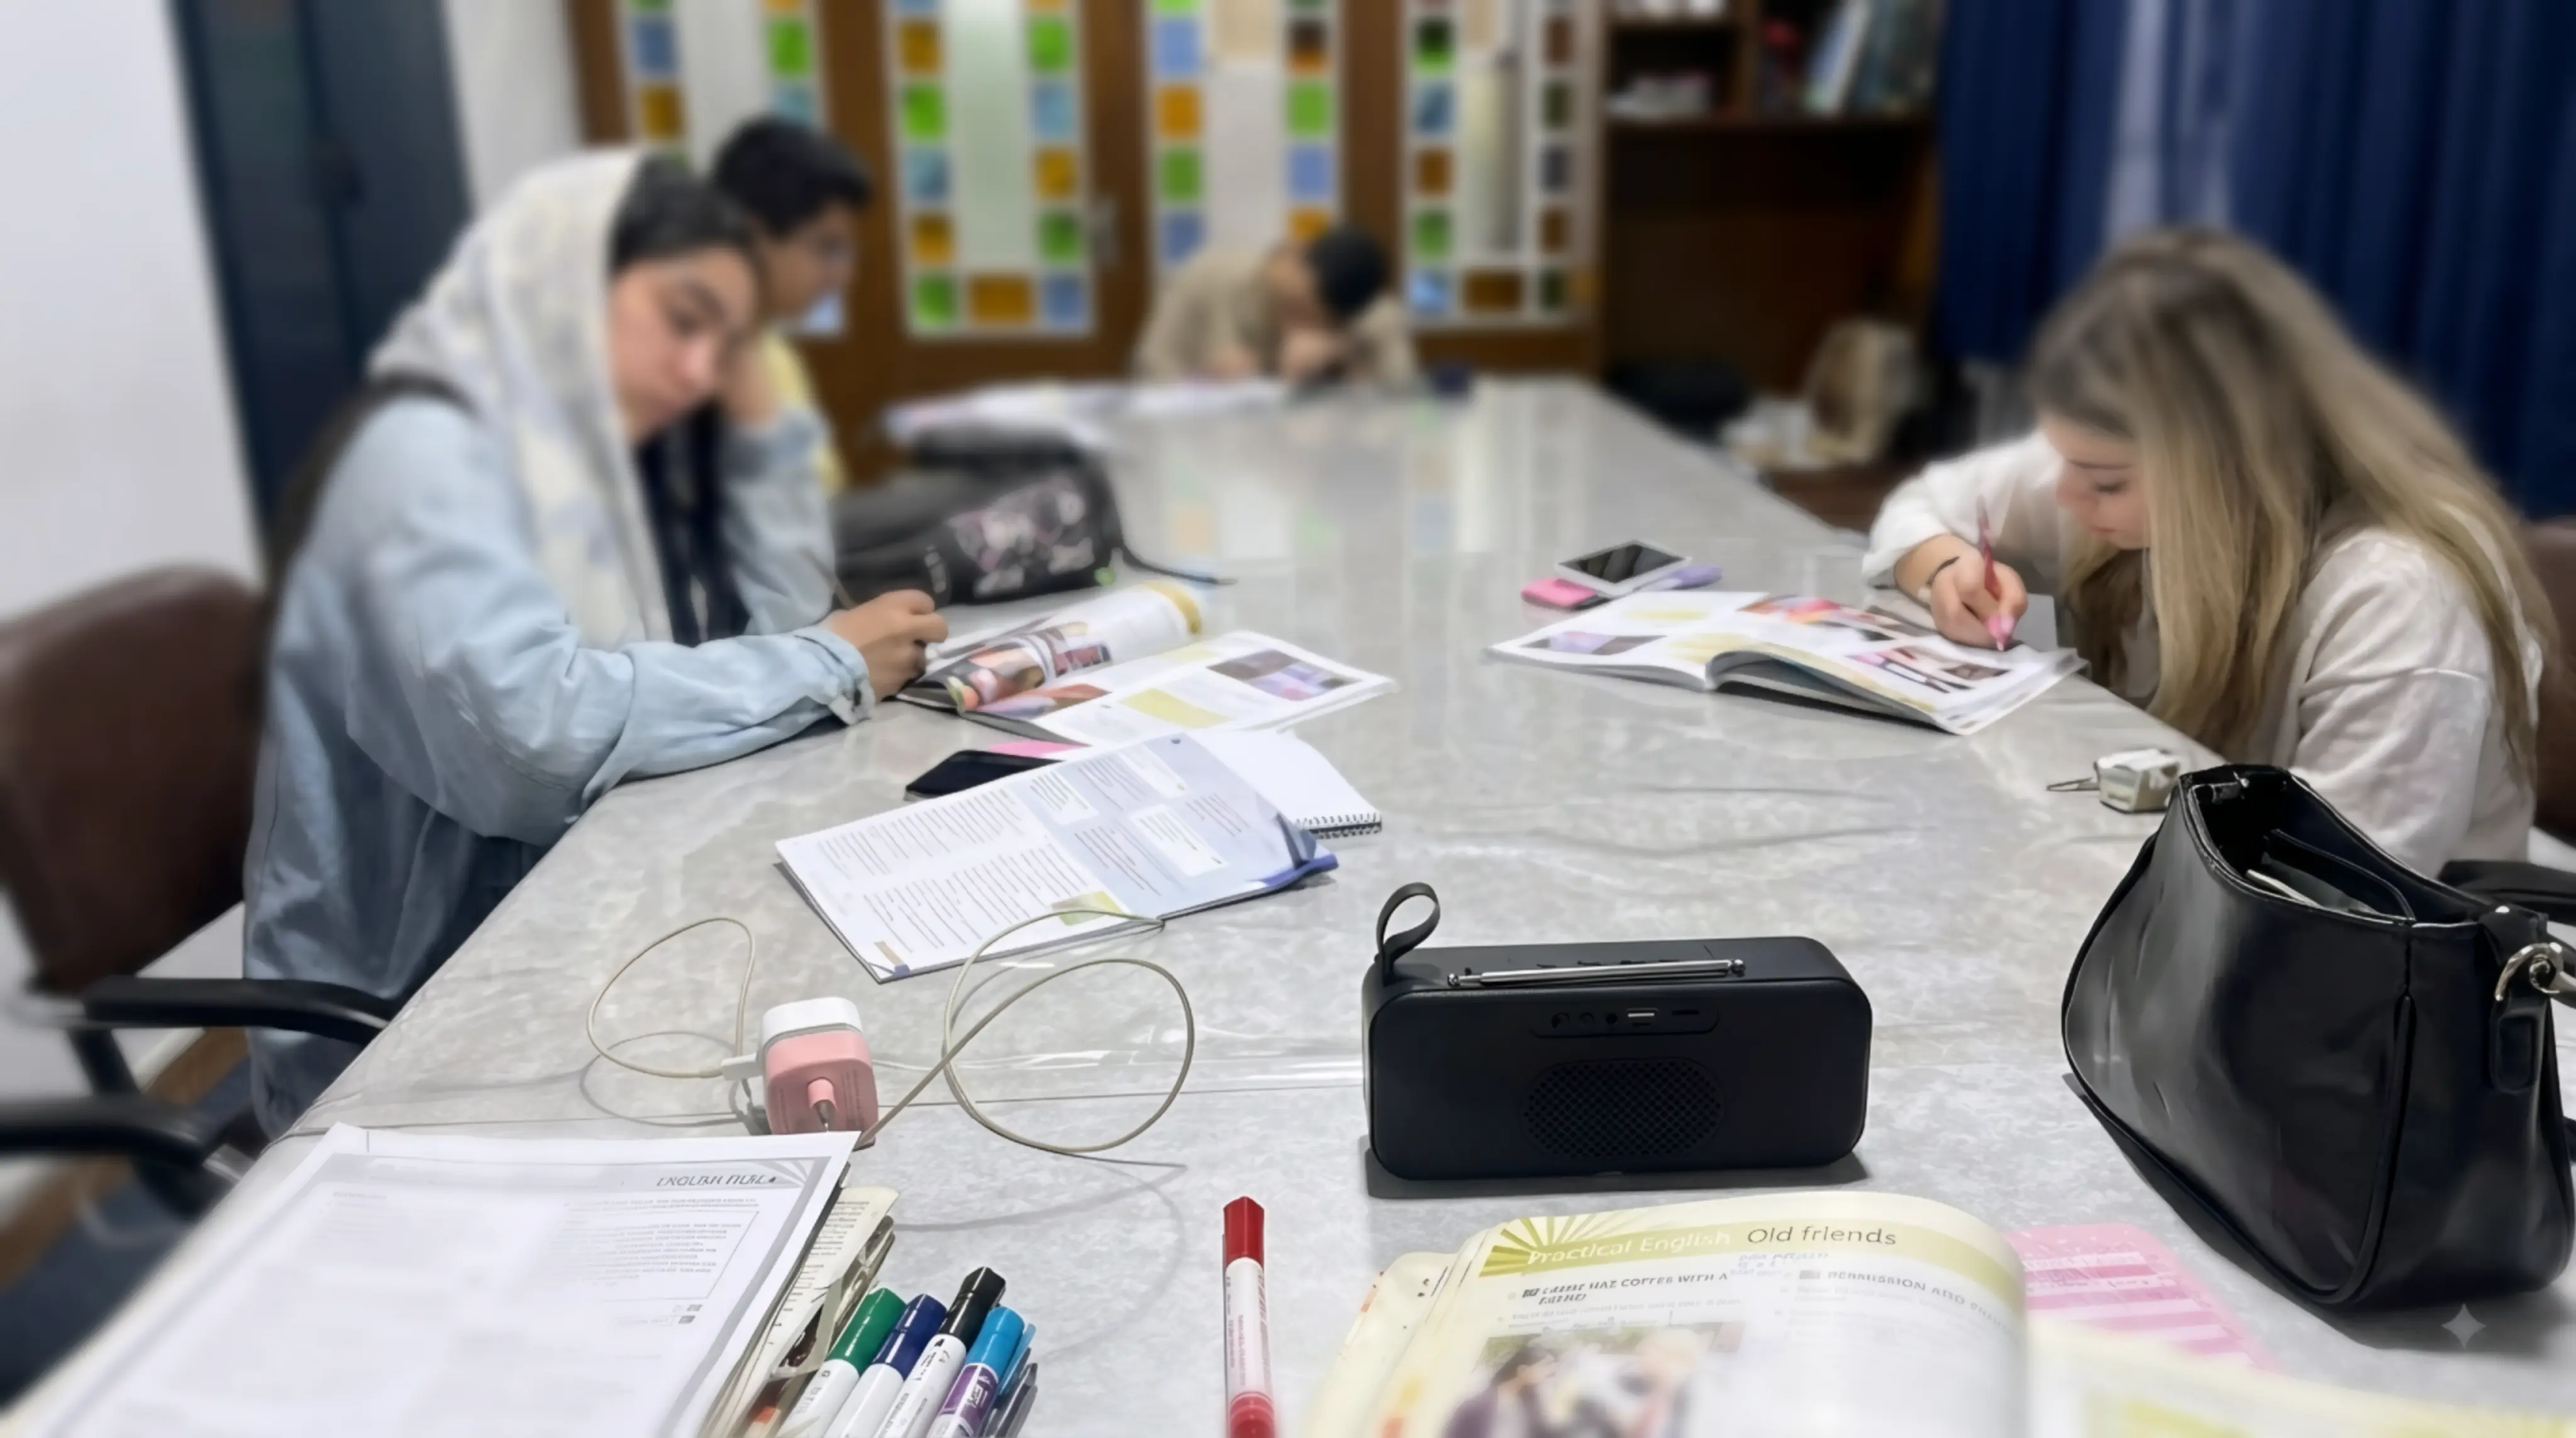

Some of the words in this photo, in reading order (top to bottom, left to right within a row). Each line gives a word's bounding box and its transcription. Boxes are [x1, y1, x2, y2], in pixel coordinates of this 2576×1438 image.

[1527, 1239, 1633, 1265] Practical
[1640, 1230, 1730, 1252] English
[1747, 1226, 1793, 1244] Old
[1801, 1225, 1897, 1246] friends
